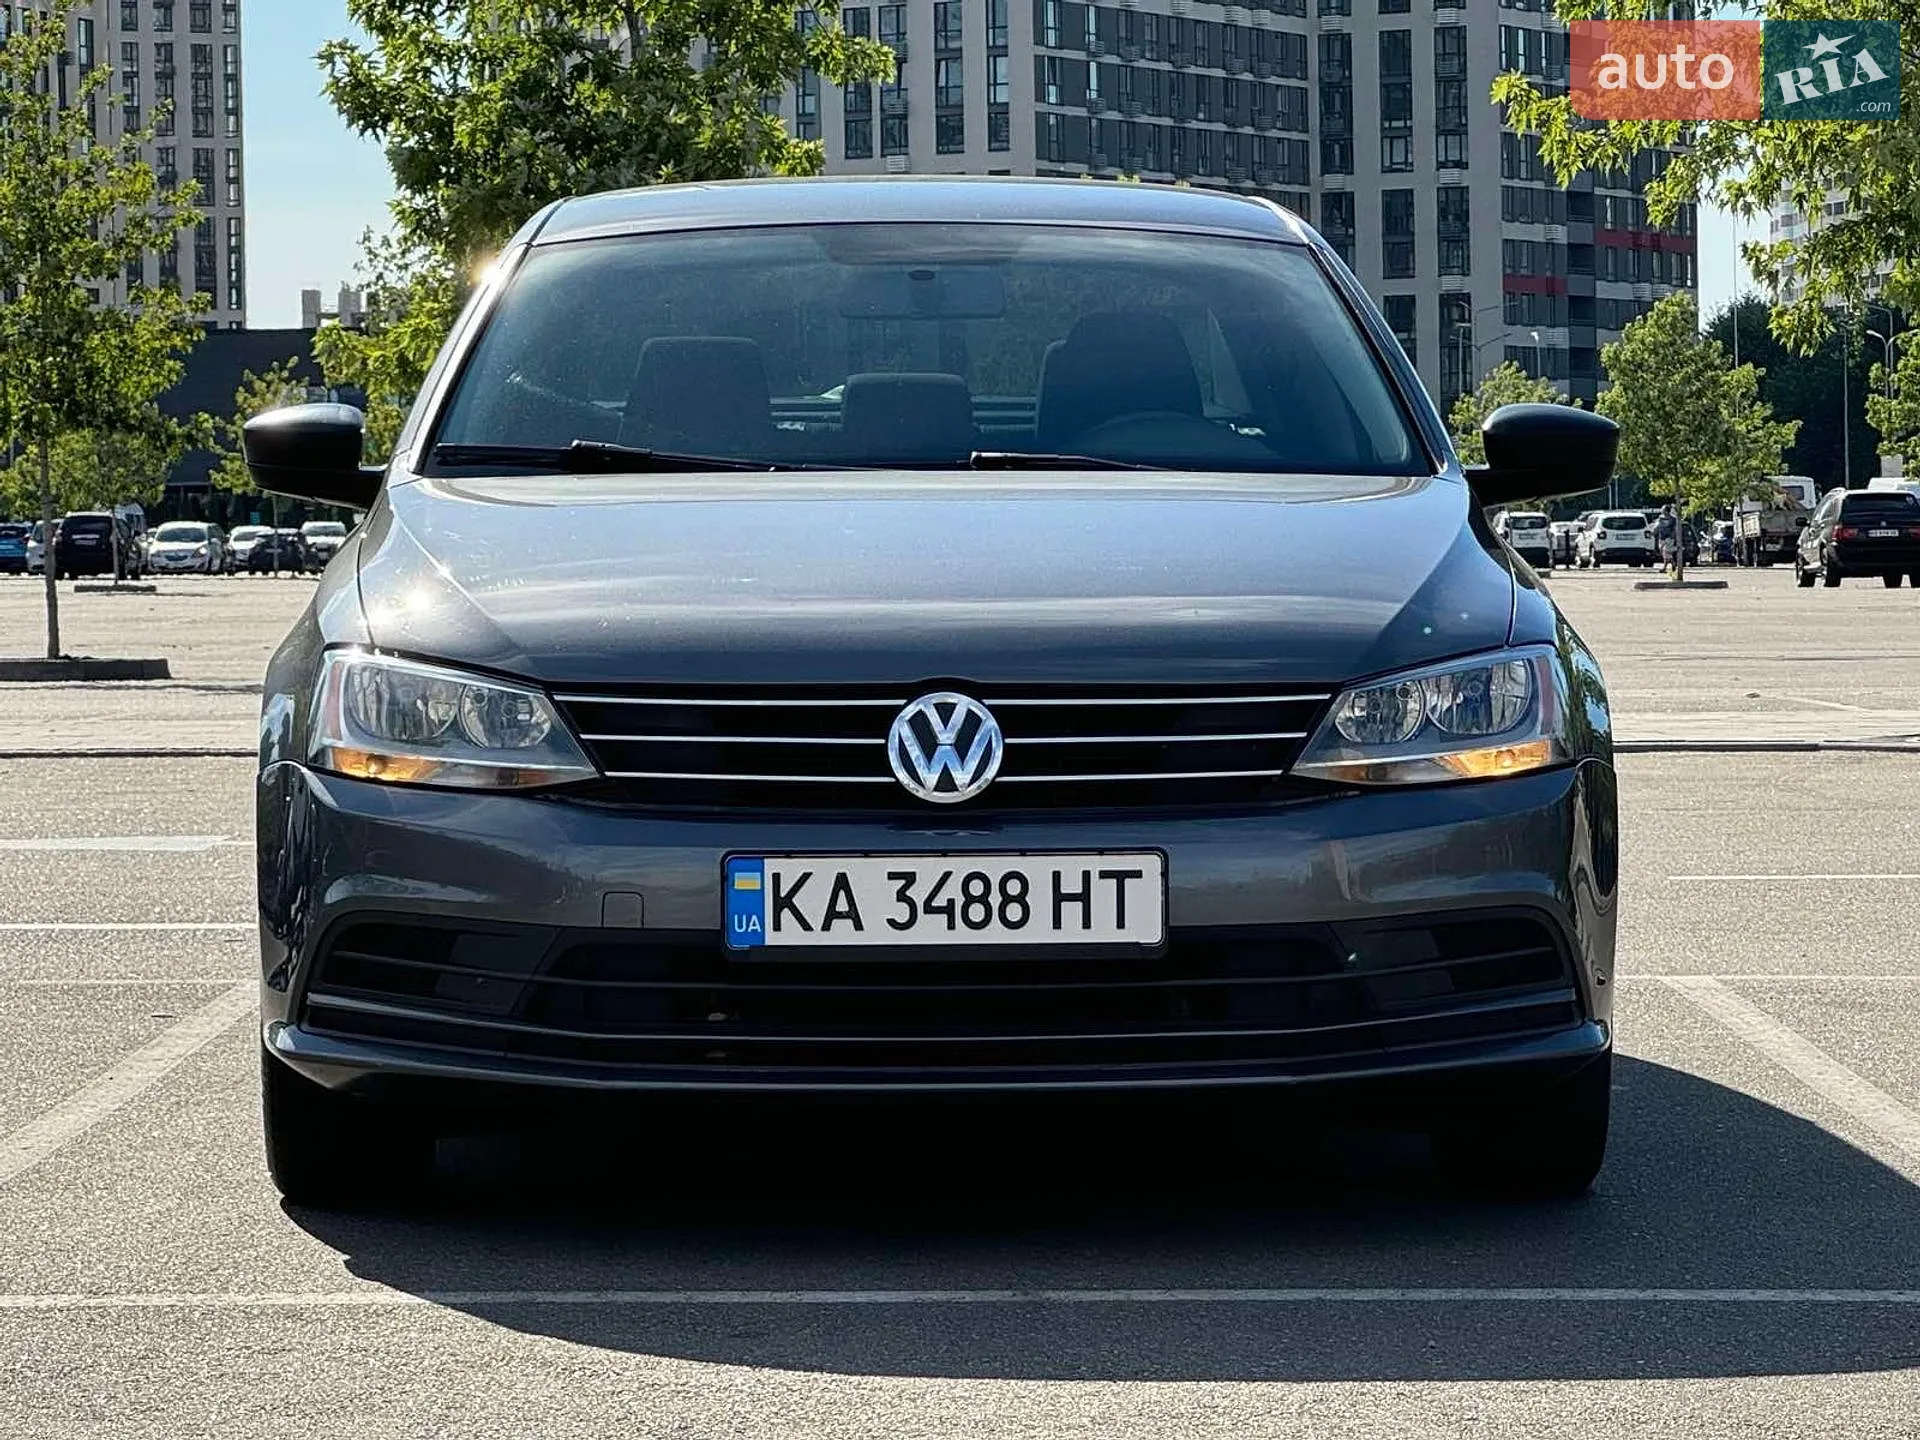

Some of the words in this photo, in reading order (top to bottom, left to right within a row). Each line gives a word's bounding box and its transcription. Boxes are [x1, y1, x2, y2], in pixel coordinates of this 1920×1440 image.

[771, 872, 864, 933] KA
[885, 871, 1030, 931] 3488
[1052, 870, 1143, 930] HT
[734, 914, 762, 933] UA
